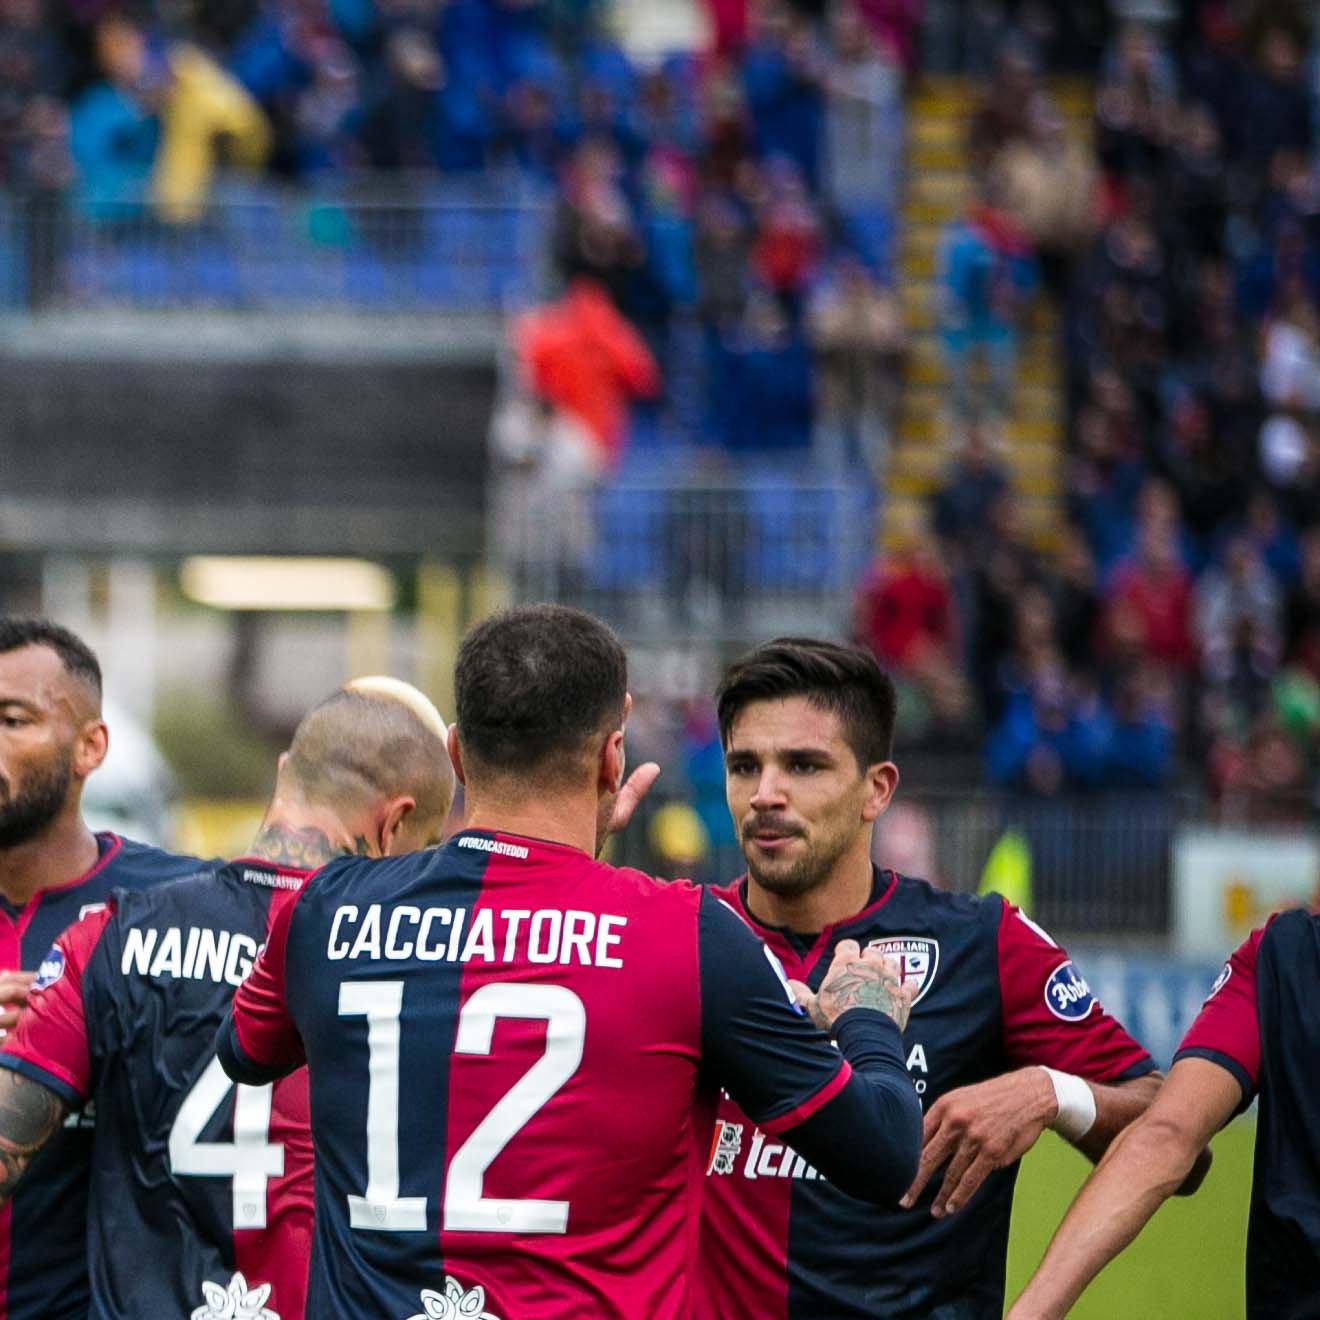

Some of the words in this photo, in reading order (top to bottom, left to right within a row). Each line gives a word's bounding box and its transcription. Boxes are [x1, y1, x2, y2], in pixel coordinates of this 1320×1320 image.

[121, 927, 266, 987] NAING
[327, 904, 627, 969] CACCIATORE
[169, 1055, 285, 1228] 4
[338, 981, 586, 1233] 12
